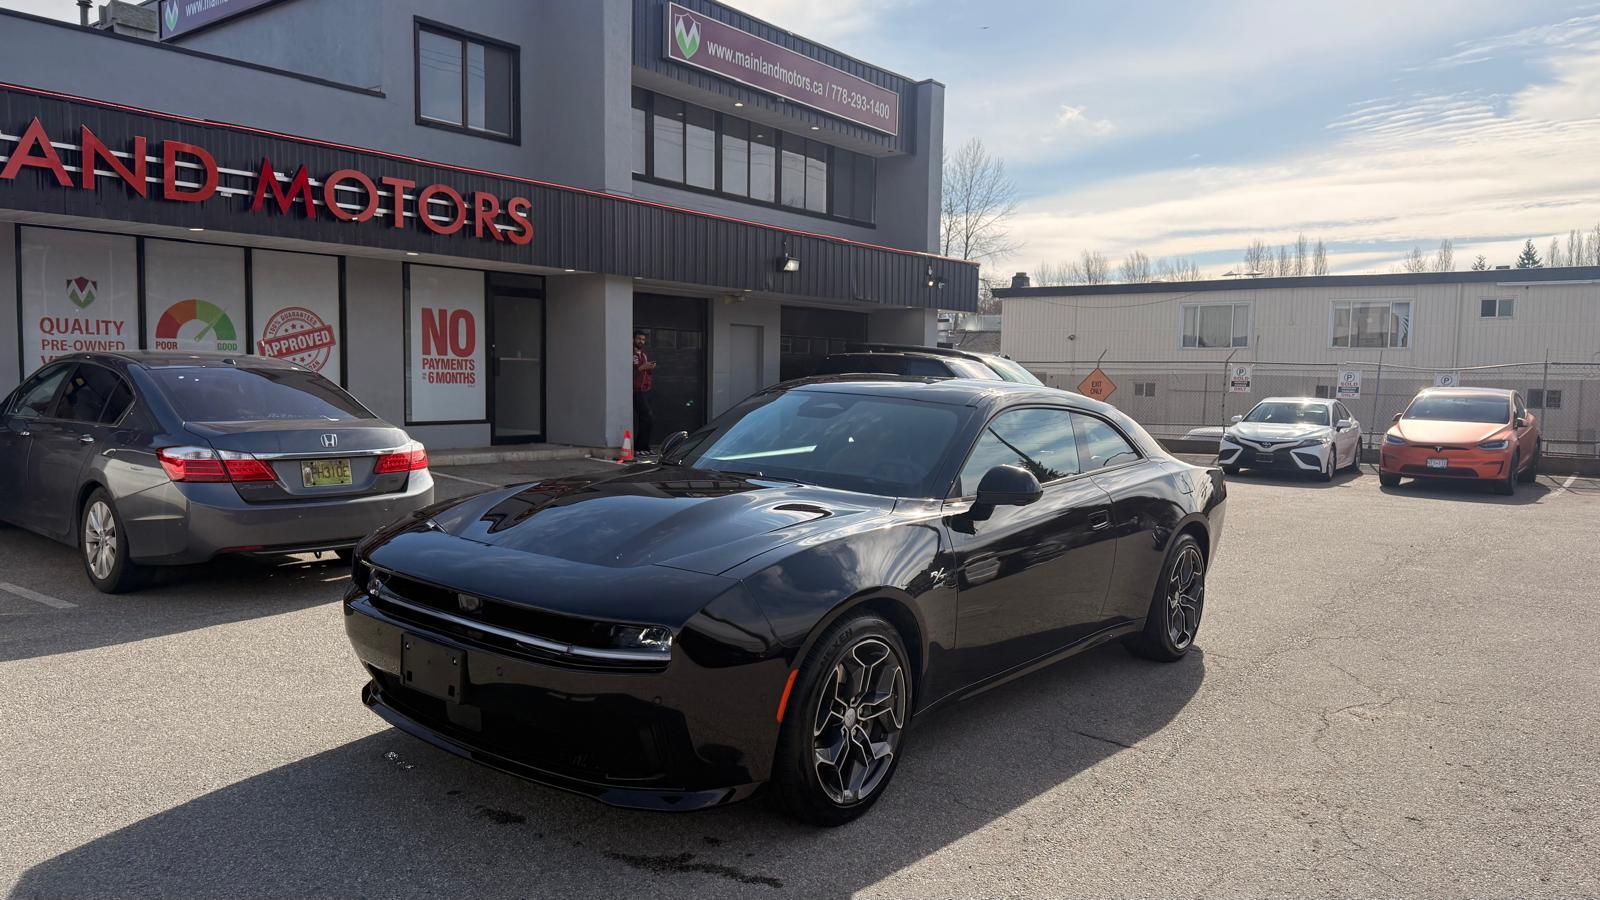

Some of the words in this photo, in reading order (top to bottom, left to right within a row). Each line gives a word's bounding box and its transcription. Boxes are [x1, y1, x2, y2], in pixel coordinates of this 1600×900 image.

[706, 40, 824, 98] www.mainlandmotors.ca
[825, 81, 829, 98] /
[831, 84, 890, 120] 778-293-1400
[252, 154, 534, 245] MOTORS
[39, 316, 125, 336] QUALITY
[421, 307, 476, 358] NO
[155, 341, 178, 350] POOR
[216, 342, 238, 351] GOOD
[264, 330, 331, 357] APPROVED
[422, 358, 476, 371] PAYMENTS
[428, 371, 435, 384] 6
[436, 371, 476, 384] MONTHS
